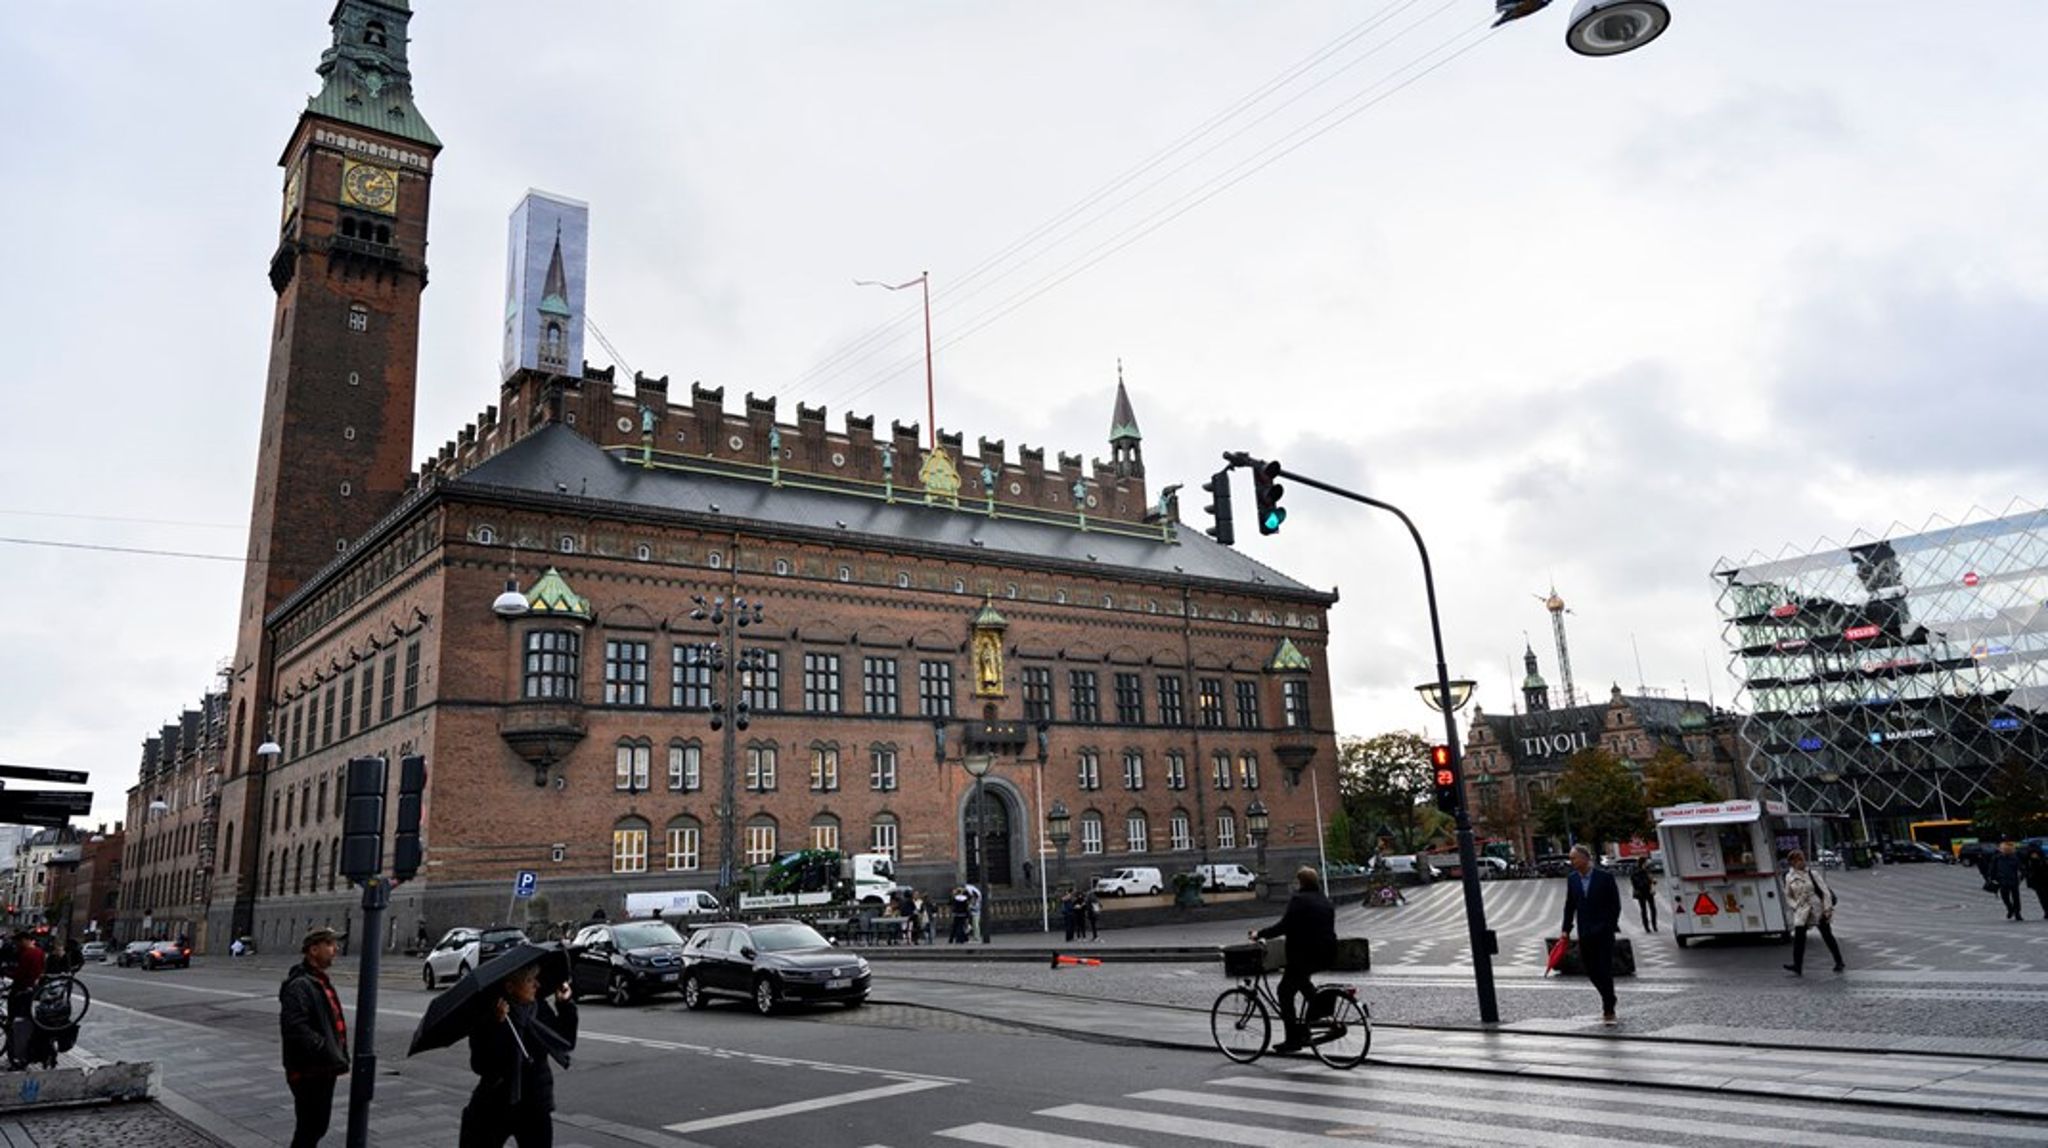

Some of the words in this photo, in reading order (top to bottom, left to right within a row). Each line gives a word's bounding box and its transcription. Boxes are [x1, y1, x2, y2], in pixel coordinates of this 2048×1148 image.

[1885, 728, 1936, 740] MAERSK
[1437, 770, 1453, 785] 23
[522, 874, 533, 887] P
